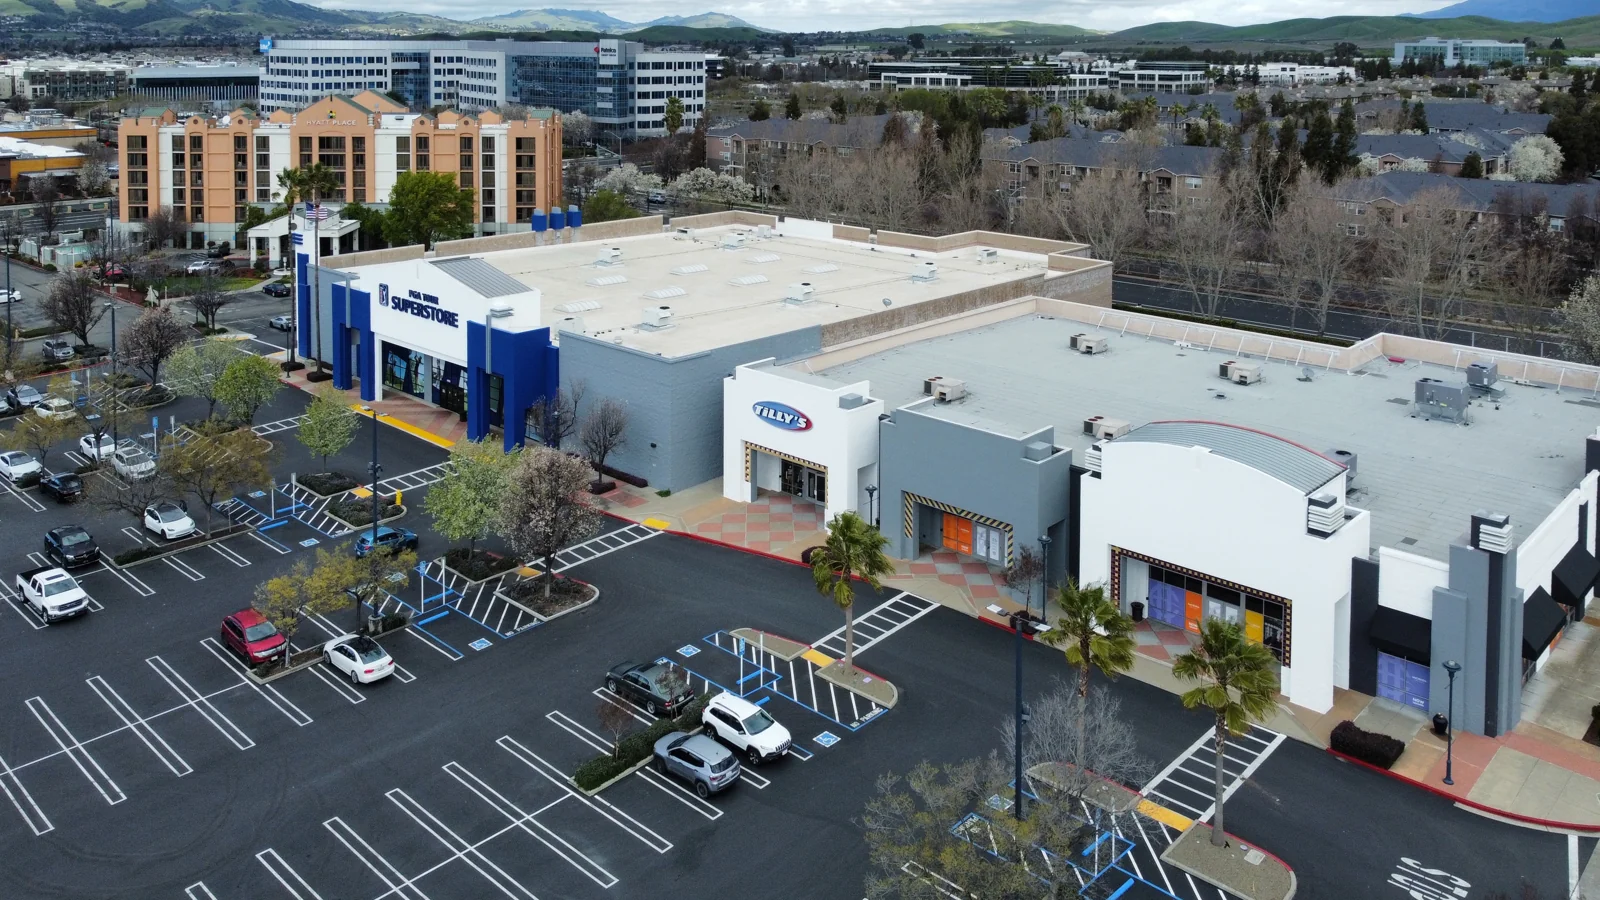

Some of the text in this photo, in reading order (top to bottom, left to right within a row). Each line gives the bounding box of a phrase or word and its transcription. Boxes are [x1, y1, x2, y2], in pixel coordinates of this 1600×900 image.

[408, 289, 440, 305] PGA TOUR
[391, 295, 459, 329] SUPERSTORE
